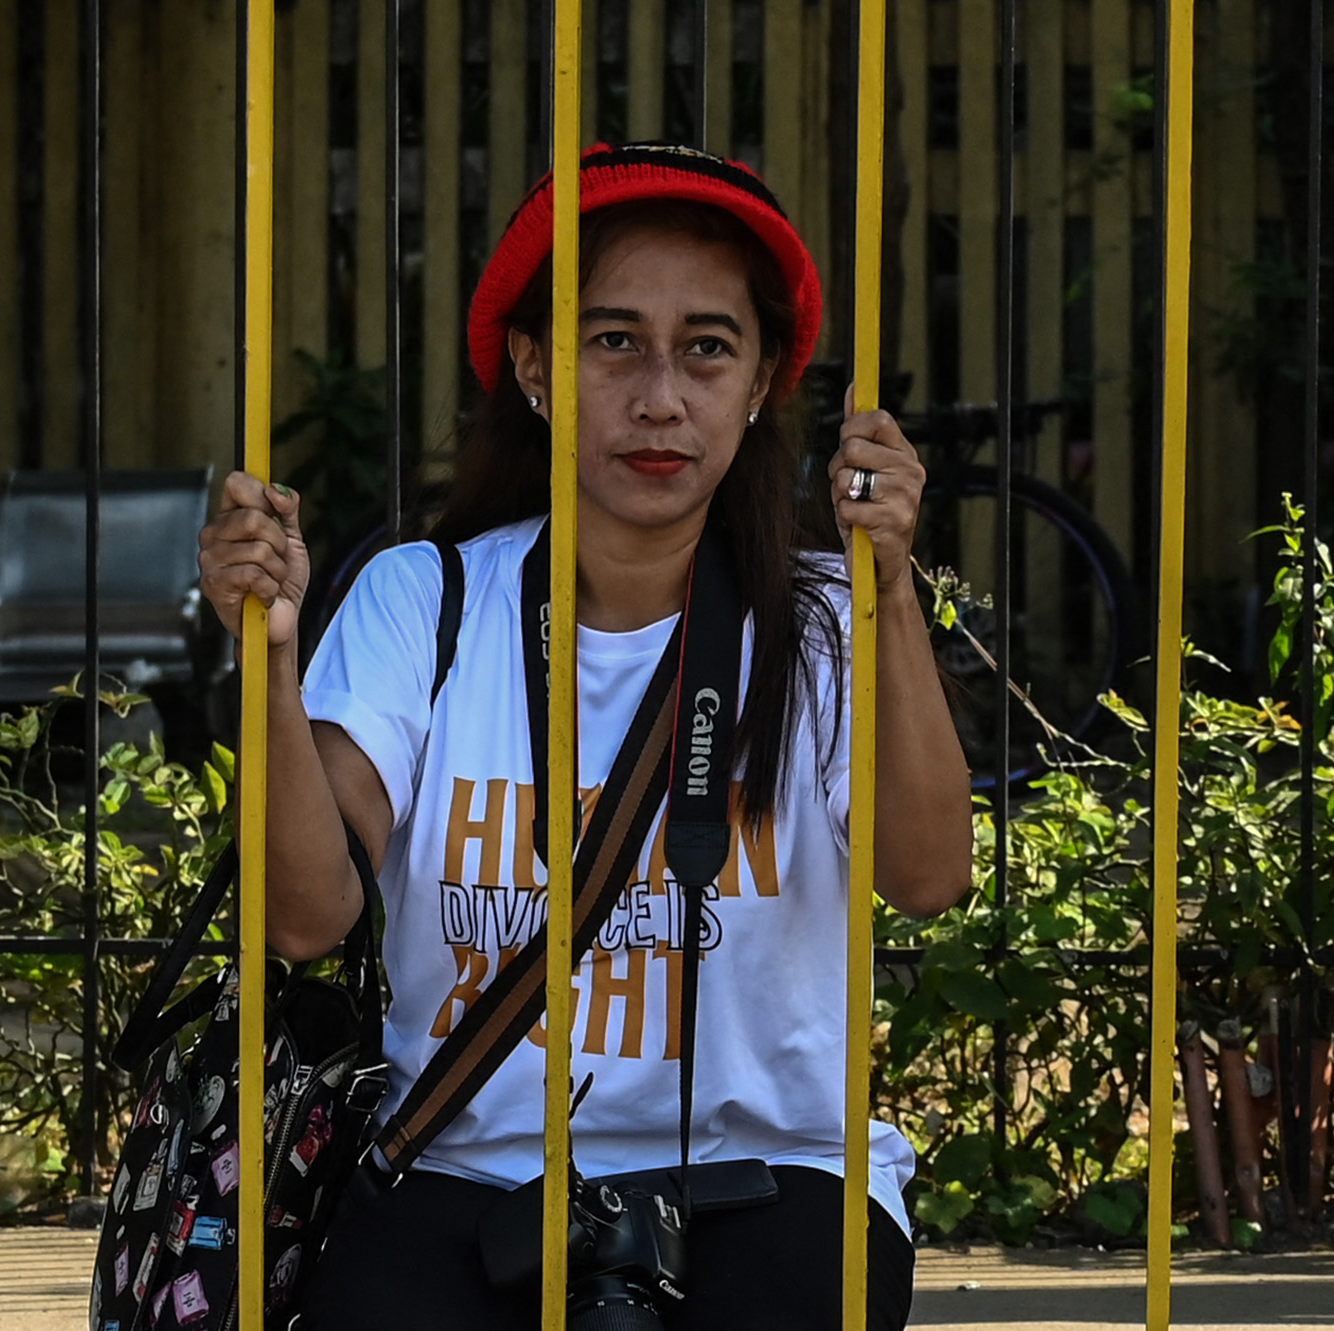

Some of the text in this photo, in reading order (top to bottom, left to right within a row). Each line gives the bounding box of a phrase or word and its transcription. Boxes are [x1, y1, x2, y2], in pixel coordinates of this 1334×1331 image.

[687, 687, 721, 796] Canon
[439, 879, 656, 953] DIVCE
[429, 940, 707, 1061] RHT
